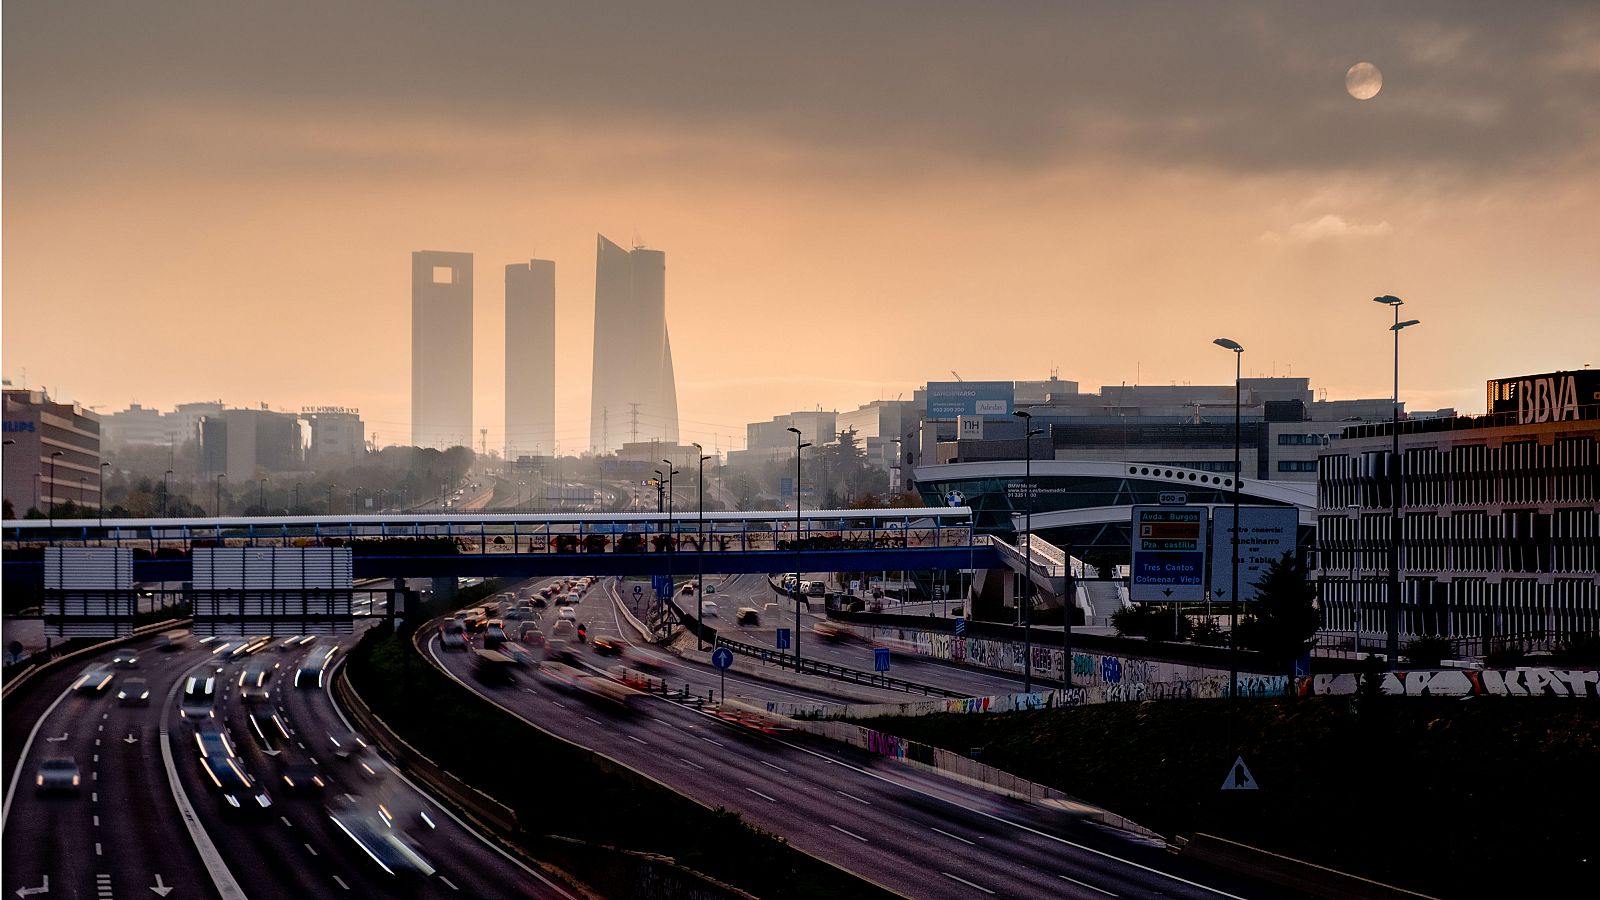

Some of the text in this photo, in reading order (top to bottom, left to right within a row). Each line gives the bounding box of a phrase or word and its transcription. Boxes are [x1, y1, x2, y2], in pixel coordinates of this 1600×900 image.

[1519, 376, 1579, 424] BBVA
[1169, 513, 1198, 521] Burgos
[1136, 575, 1200, 584] Colmenar Viejo
